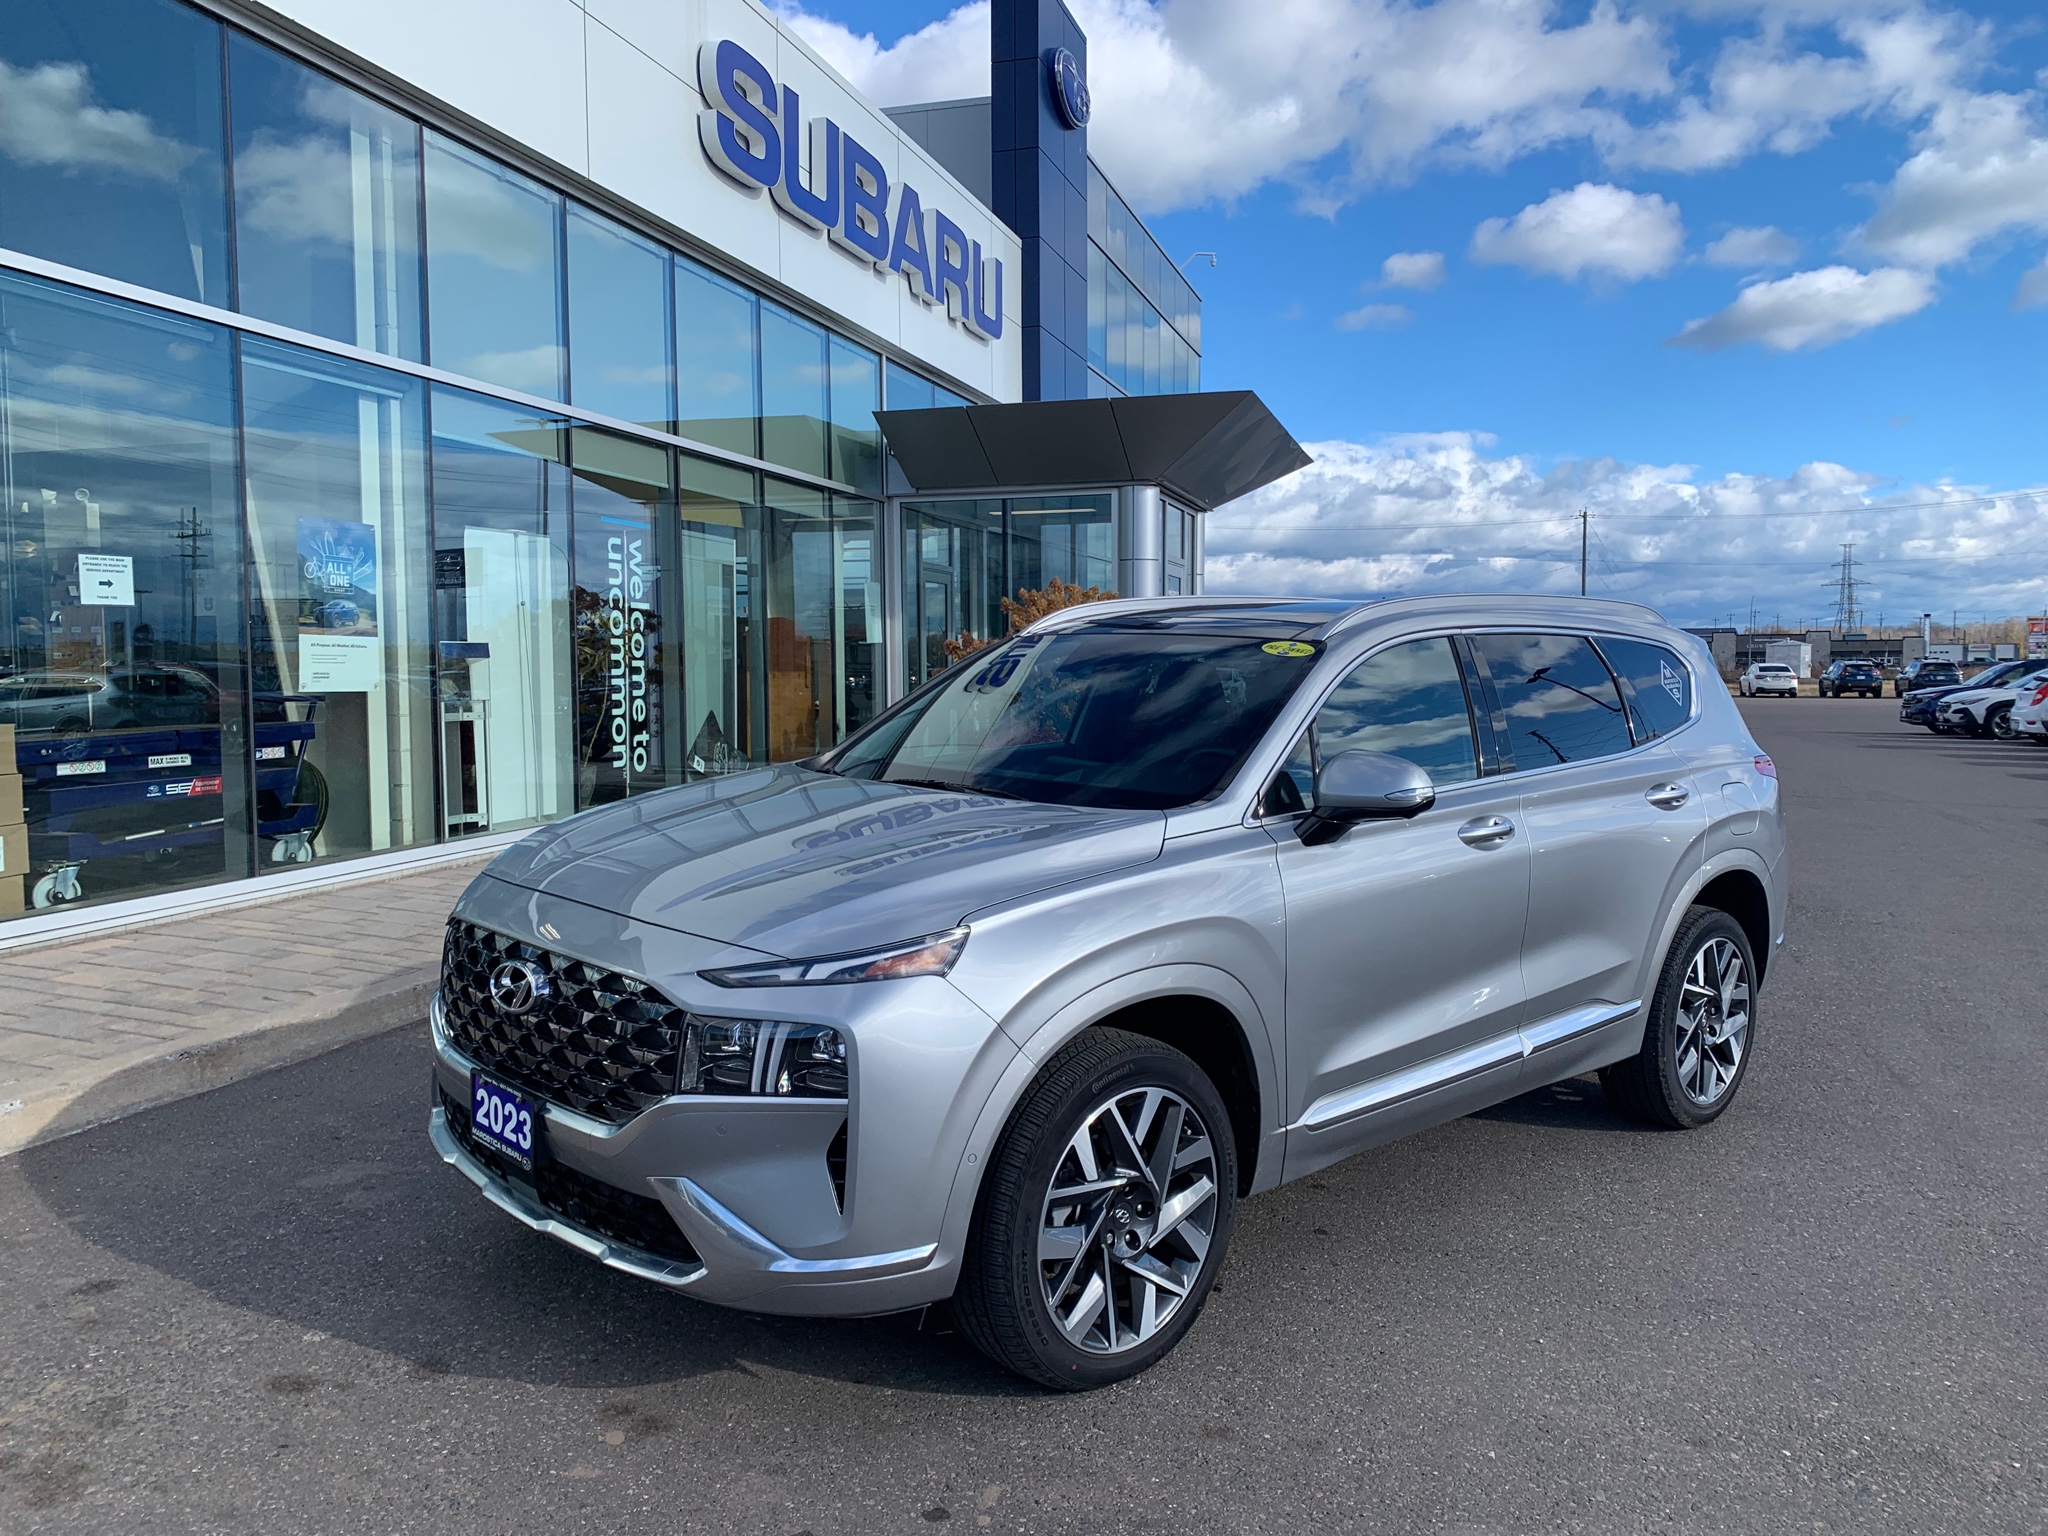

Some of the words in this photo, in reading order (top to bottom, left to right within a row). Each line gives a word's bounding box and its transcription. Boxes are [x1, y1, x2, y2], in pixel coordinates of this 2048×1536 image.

[703, 39, 1003, 340] SUBARU
[327, 562, 346, 575] ALL
[330, 574, 350, 587] ONE
[629, 538, 650, 723] welcome
[607, 537, 627, 769] uncommon
[1672, 688, 1680, 698] S
[150, 757, 164, 766] MAX
[633, 731, 650, 773] to
[1092, 1064, 1130, 1093] Continental
[476, 1088, 532, 1150] 2023
[501, 1144, 522, 1162] SUBARU
